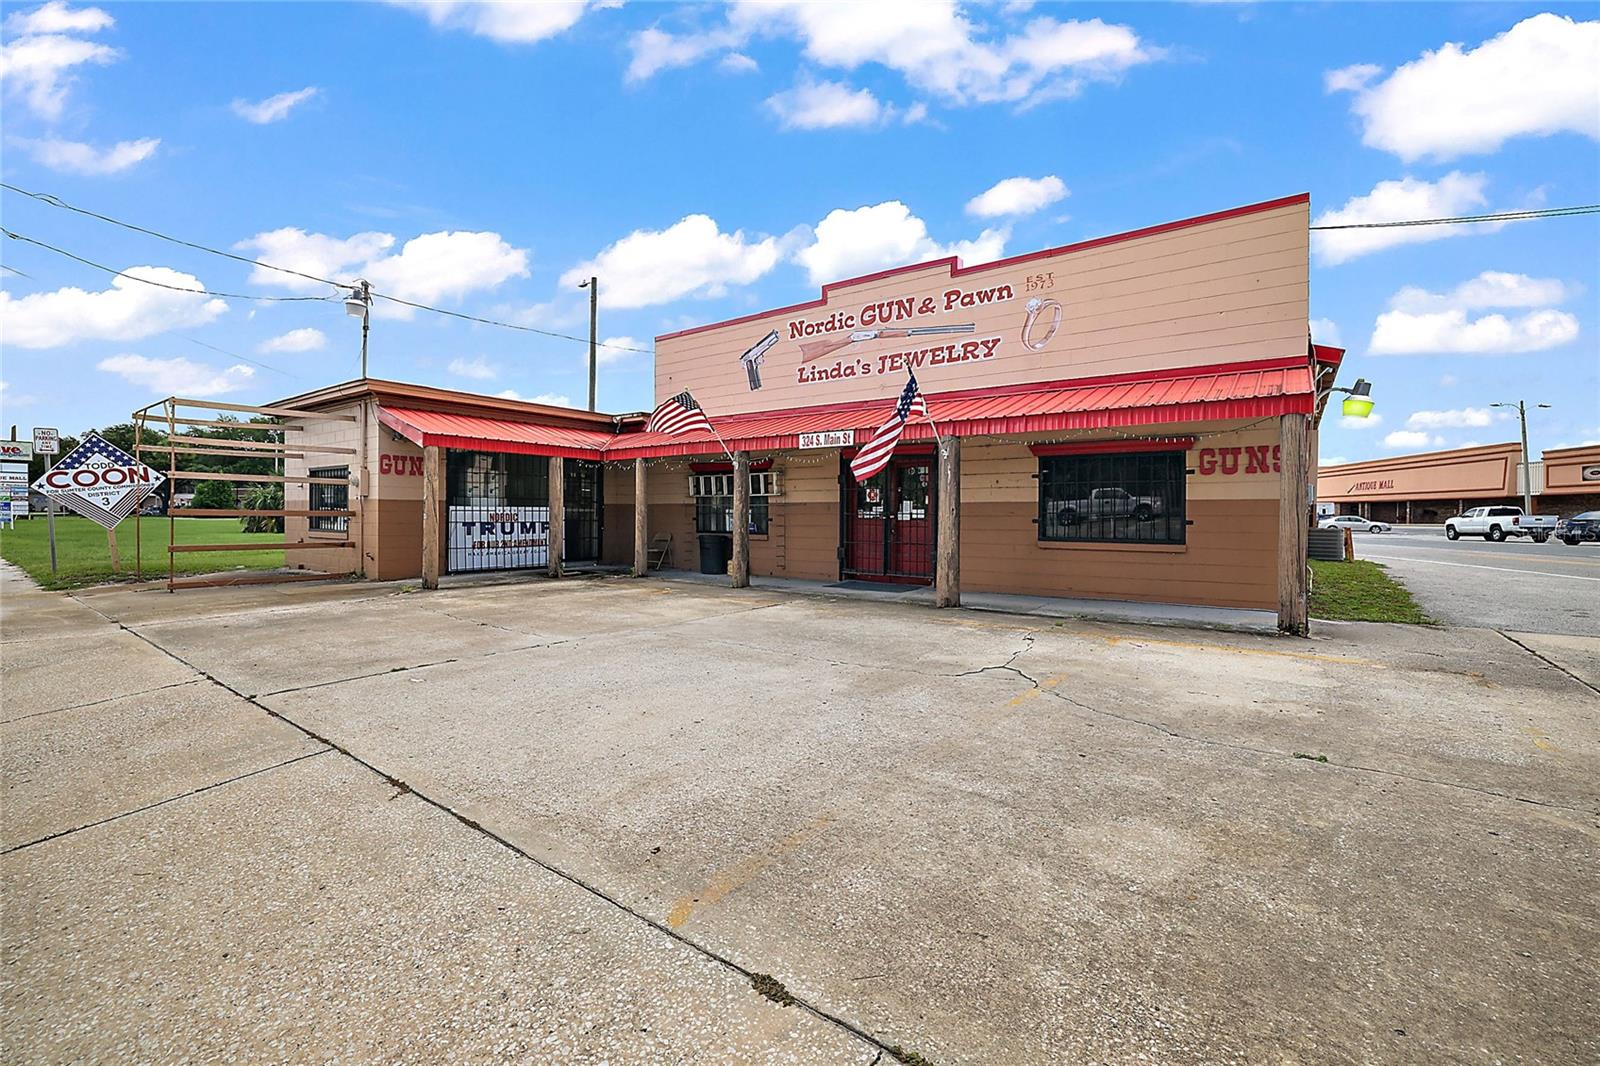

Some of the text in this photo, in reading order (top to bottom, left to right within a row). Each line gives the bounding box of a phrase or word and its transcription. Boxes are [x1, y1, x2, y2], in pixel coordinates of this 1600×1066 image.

[1026, 279, 1055, 292] 1973
[789, 285, 1014, 339] Nordic GUN & Pawn
[797, 338, 1001, 384] Linda's JEWELRY
[801, 432, 851, 447] 324 S. Main St
[84, 462, 115, 470] TODD
[46, 466, 150, 489] COON
[1355, 479, 1394, 490] ANTIQUE MALL
[101, 497, 110, 506] 3
[489, 512, 519, 522] NORDIC
